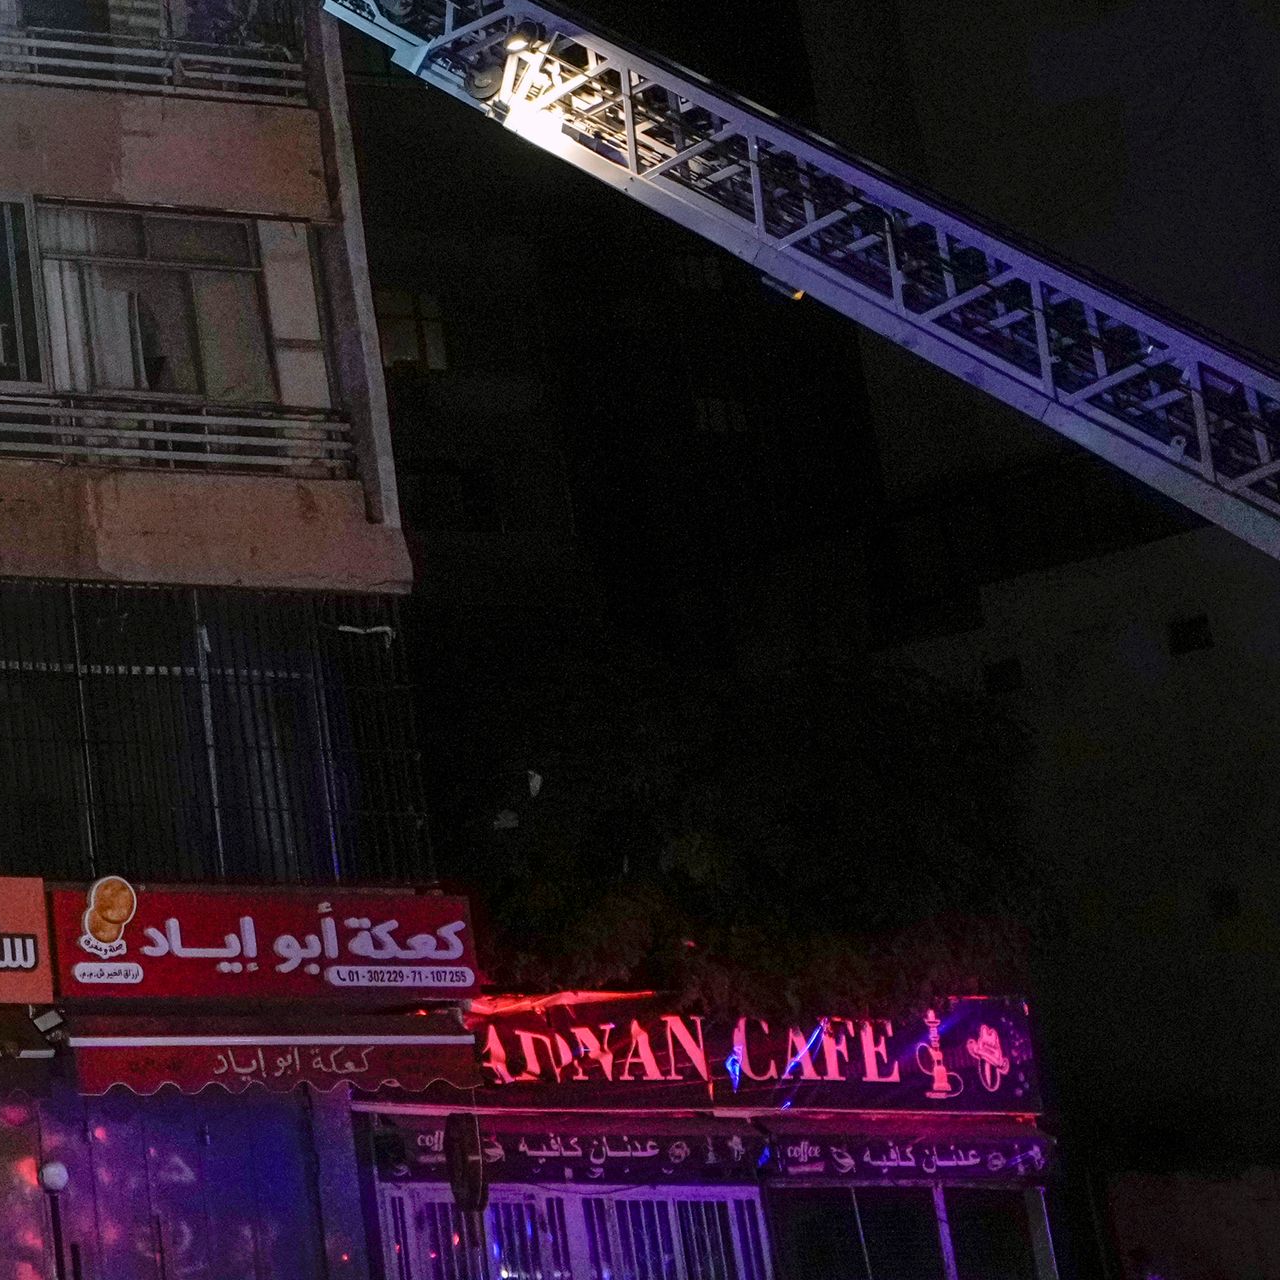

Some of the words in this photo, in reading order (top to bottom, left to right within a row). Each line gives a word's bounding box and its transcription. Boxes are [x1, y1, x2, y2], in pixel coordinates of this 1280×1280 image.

[141, 916, 259, 974] إياد
[273, 902, 339, 975] أبو
[345, 916, 467, 961] كعكة
[312, 1045, 375, 1074] كعكة
[482, 1015, 708, 1085] ADNAN
[732, 1016, 901, 1083] CAFE
[589, 1135, 661, 1165] عدنان
[787, 1140, 822, 1163] coffee
[921, 1144, 982, 1173] عدنان
